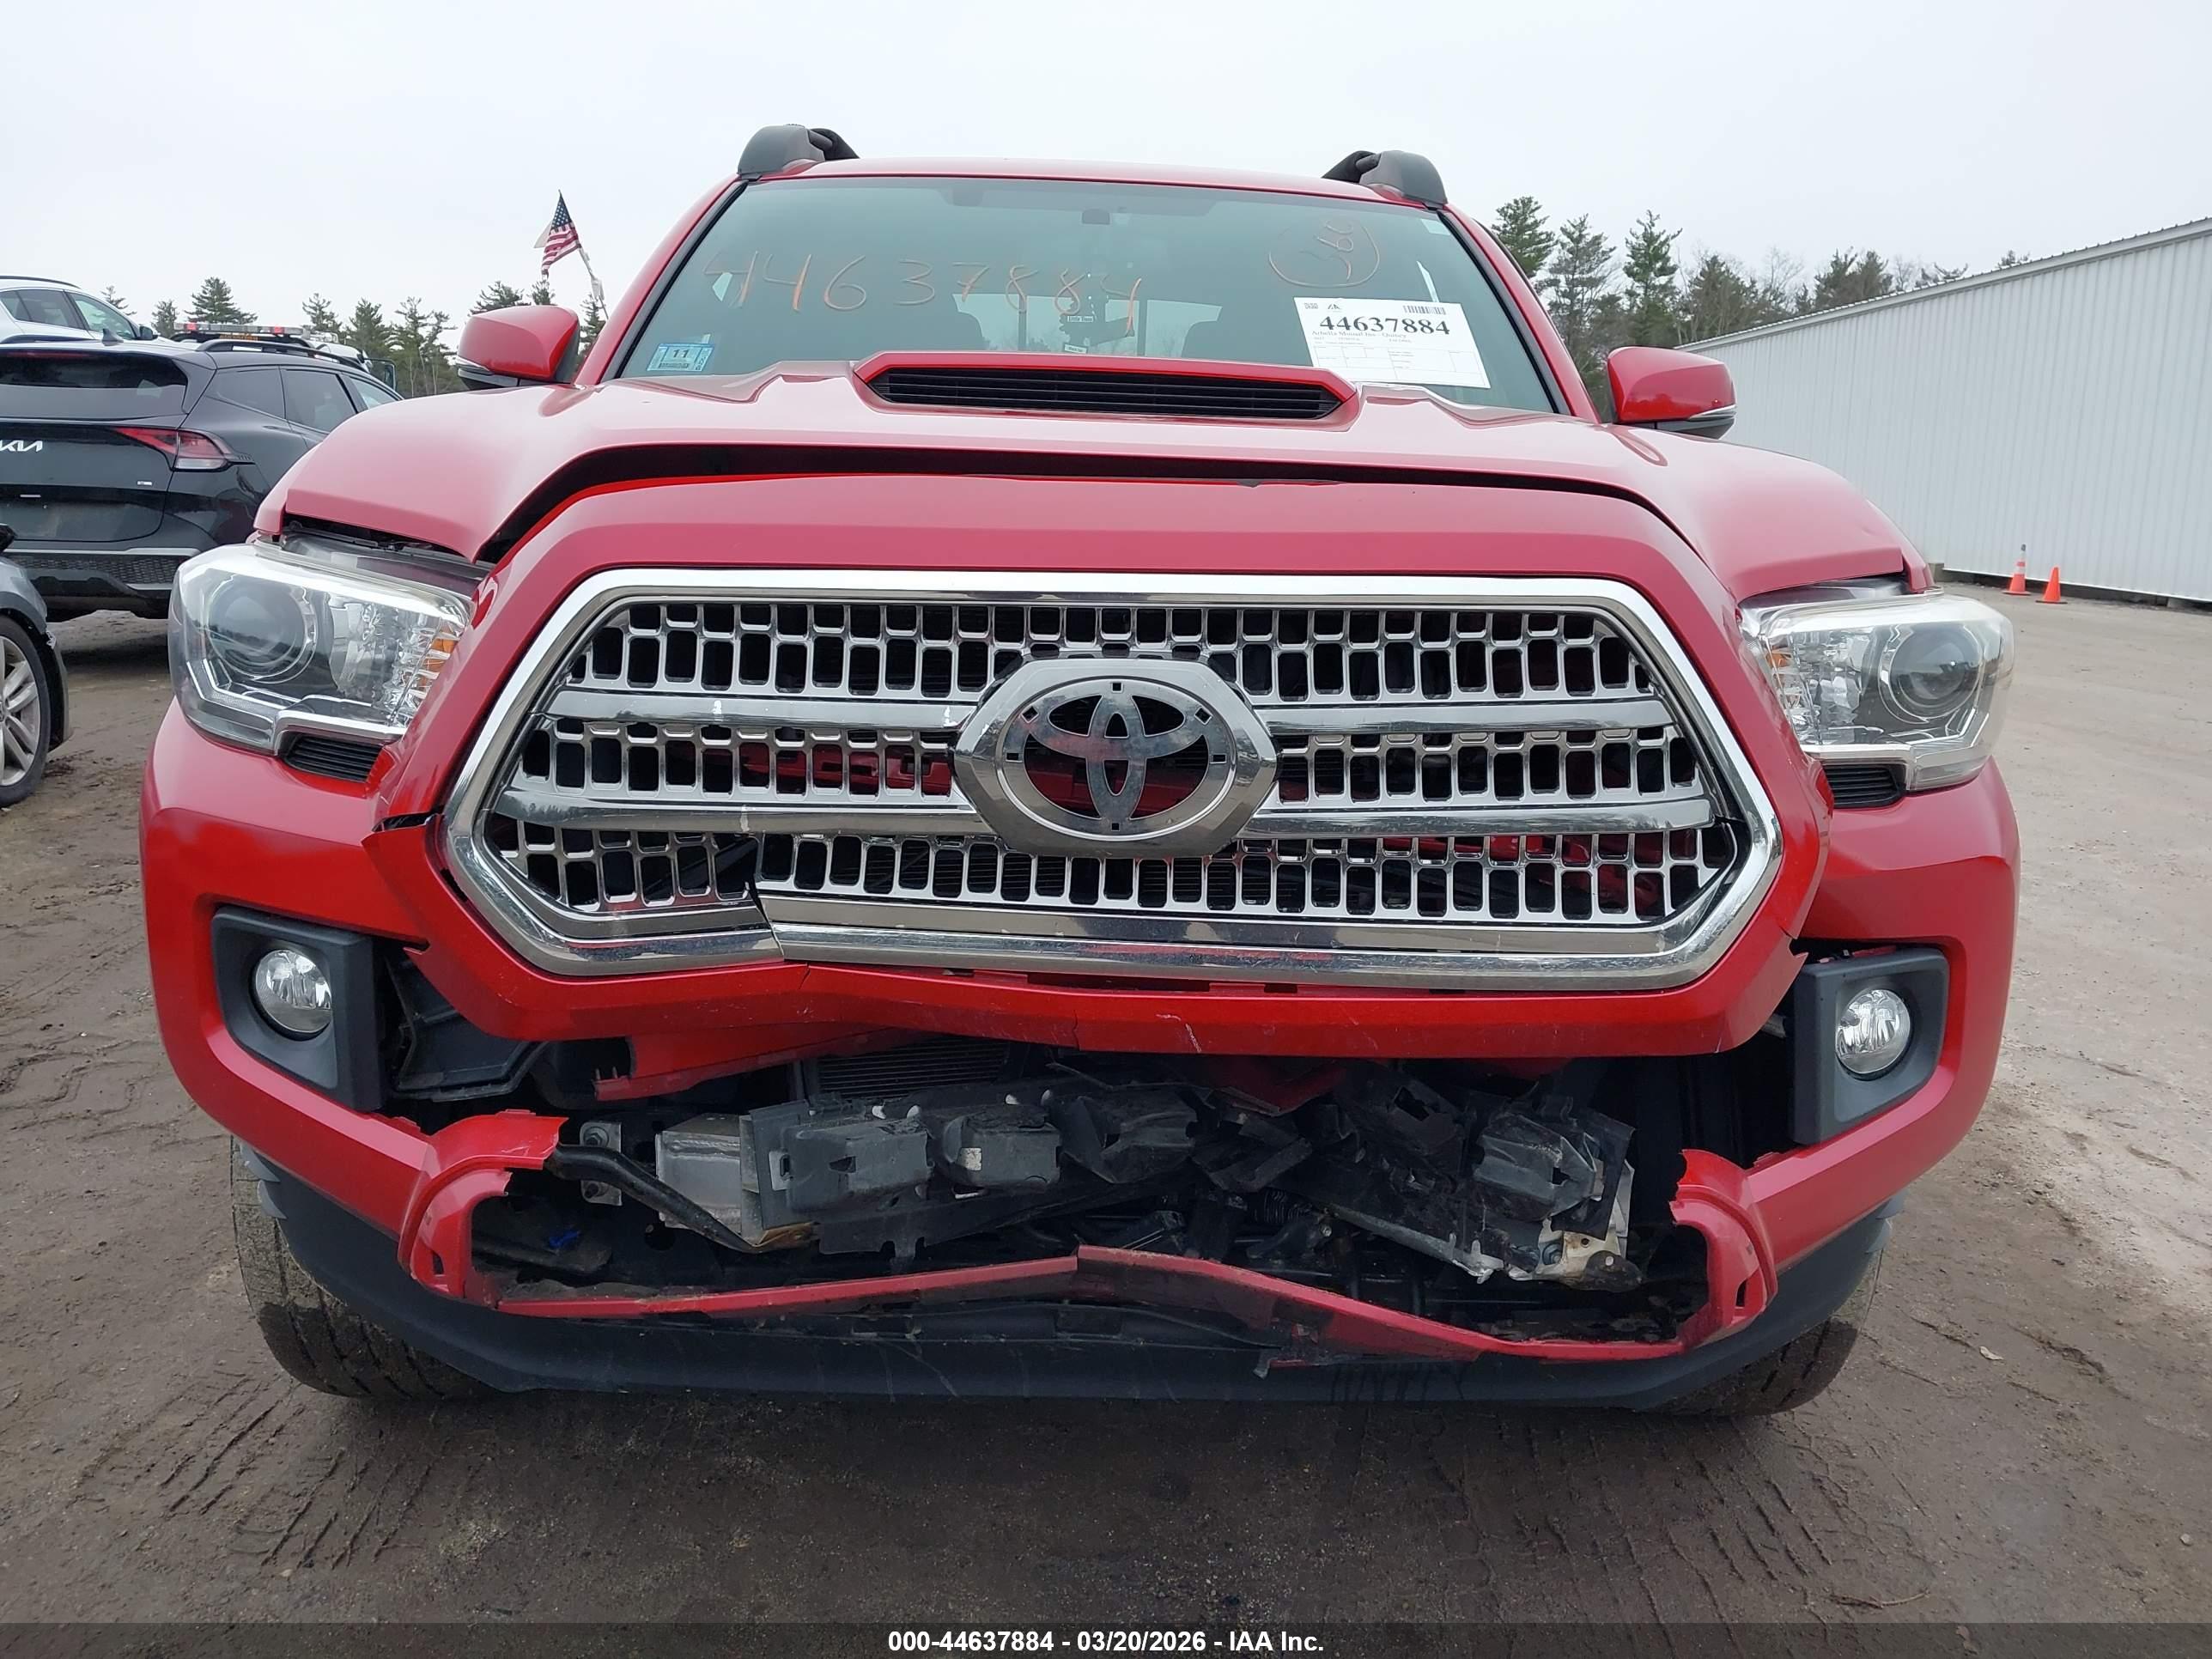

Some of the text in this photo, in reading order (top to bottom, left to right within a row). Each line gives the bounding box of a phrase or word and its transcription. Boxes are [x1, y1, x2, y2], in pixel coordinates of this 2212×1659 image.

[702, 249, 1143, 337] 44637884
[1319, 315, 1450, 335] 44637884
[672, 349, 690, 358] 11
